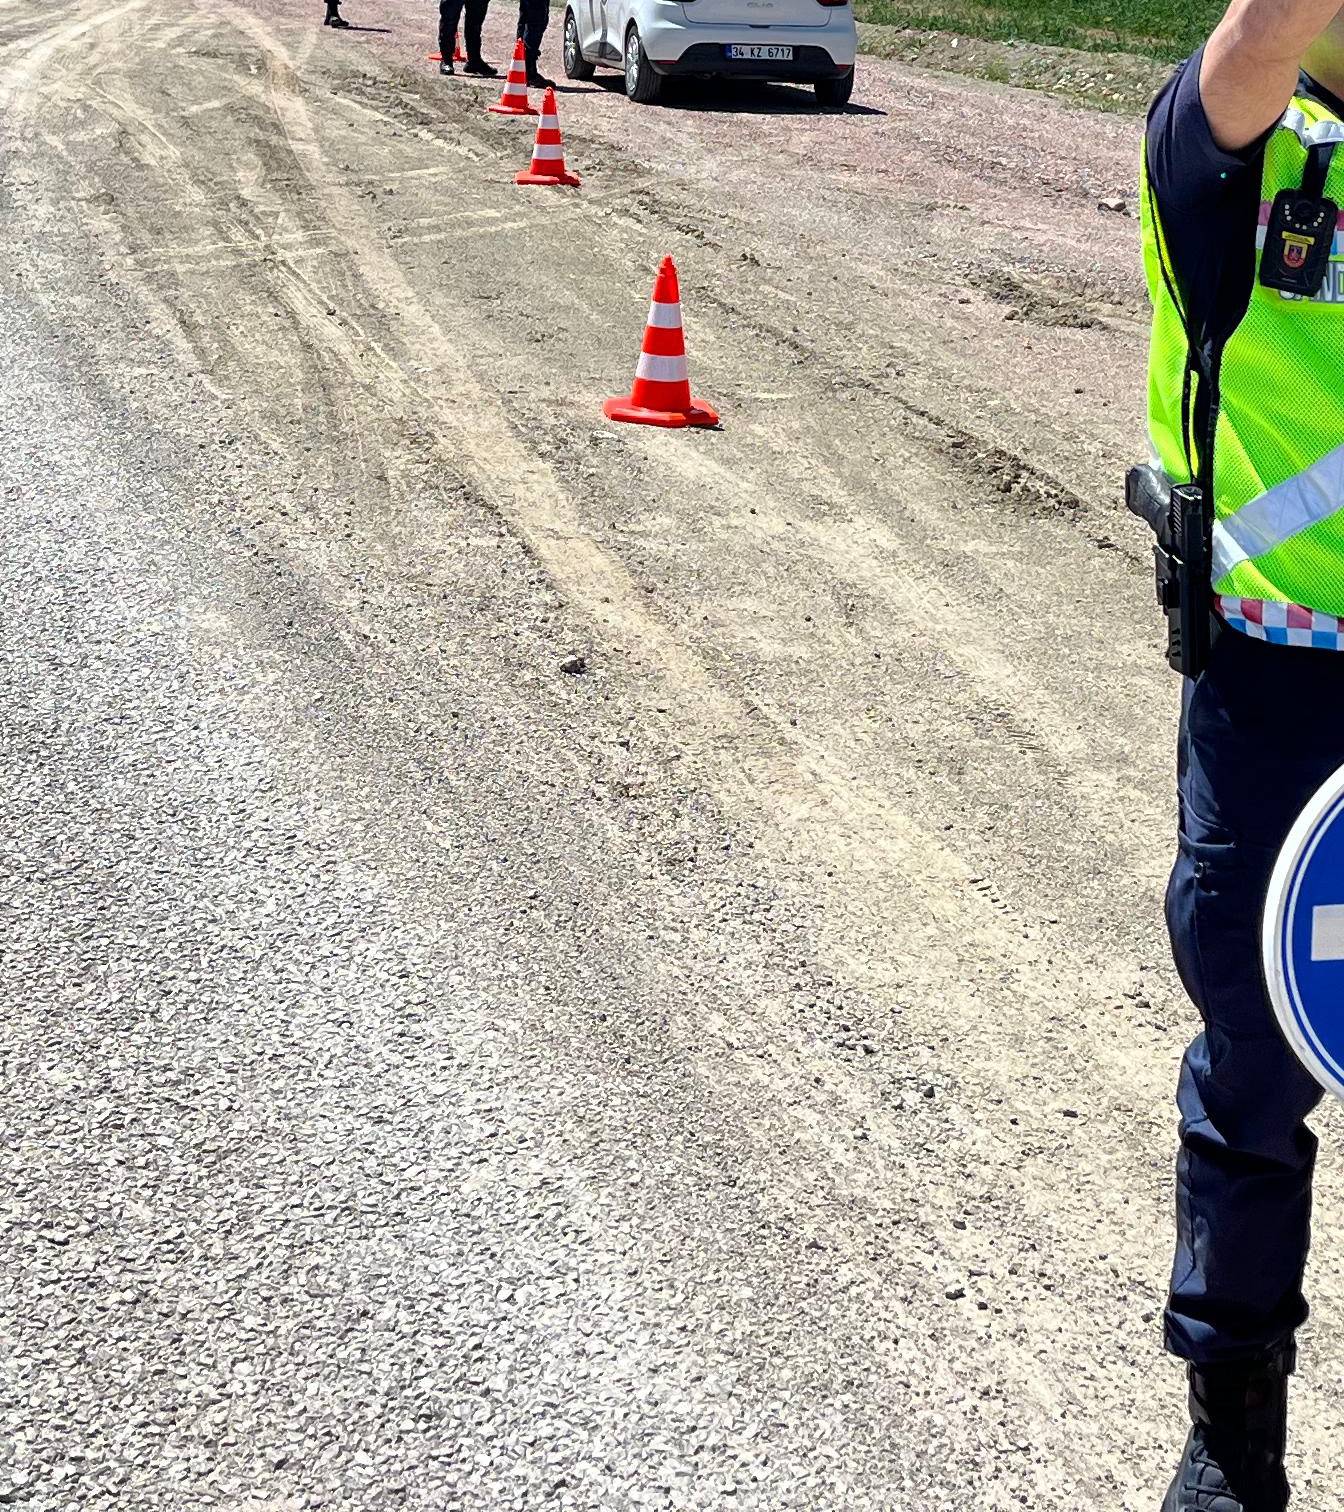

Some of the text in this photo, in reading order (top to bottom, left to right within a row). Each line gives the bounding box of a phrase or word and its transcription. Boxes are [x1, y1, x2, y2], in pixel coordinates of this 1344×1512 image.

[732, 47, 791, 59] 34 KZ 6717
